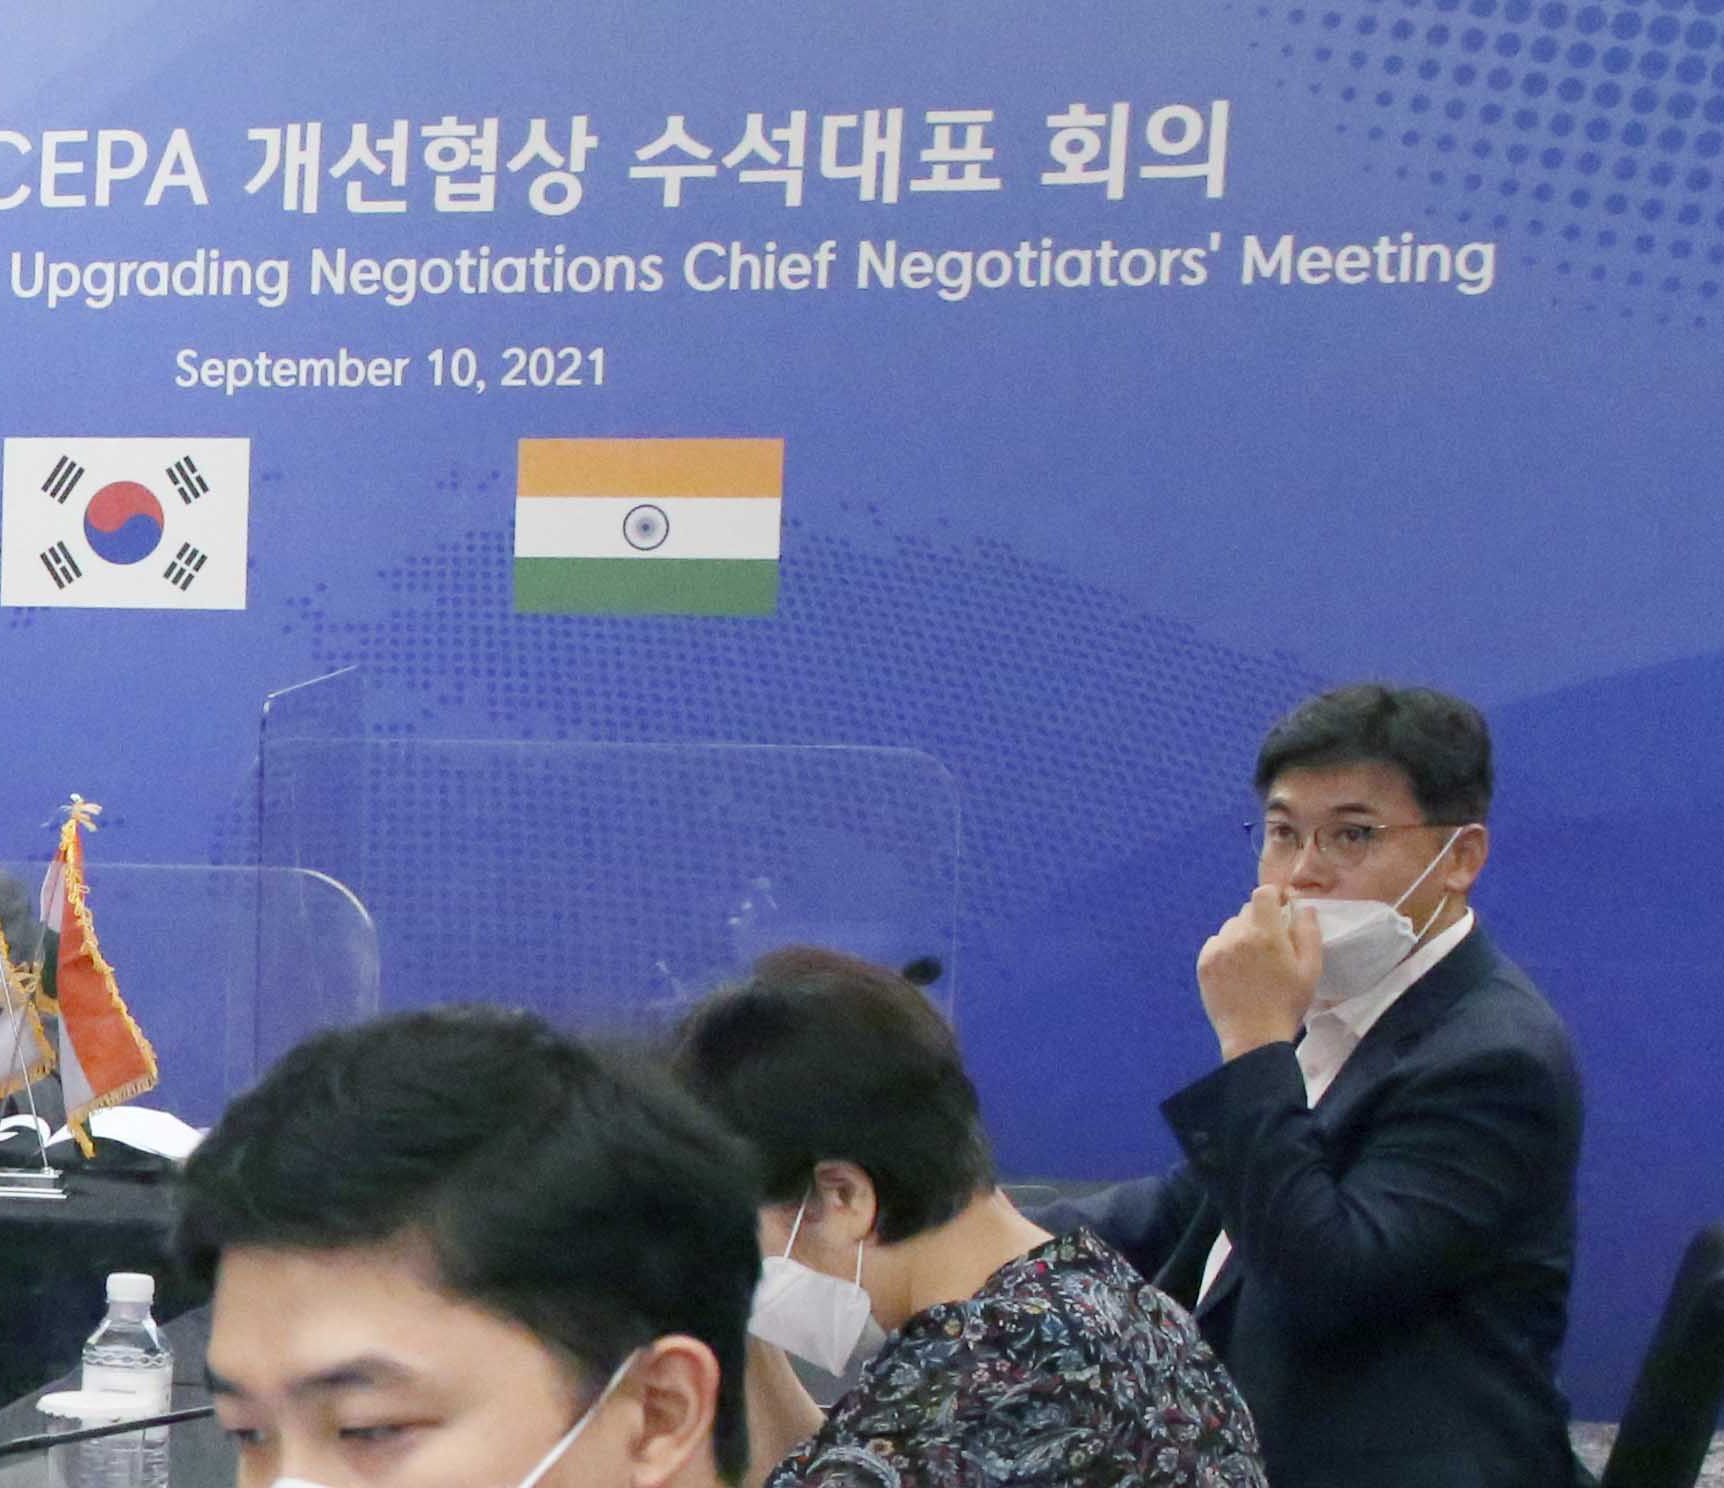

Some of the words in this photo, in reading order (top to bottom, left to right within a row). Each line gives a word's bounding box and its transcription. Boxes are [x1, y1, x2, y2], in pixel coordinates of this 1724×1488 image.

[245, 116, 599, 215] 개선협상
[630, 108, 1001, 206] 수석대표
[1042, 101, 1229, 198] 회의
[10, 249, 289, 308] Upgrading
[310, 247, 664, 305] Negotiations
[685, 241, 837, 291] Chief
[1243, 235, 1495, 295] Meeting
[175, 348, 410, 396] September
[428, 348, 486, 393] 10,
[501, 347, 604, 386] 2021
